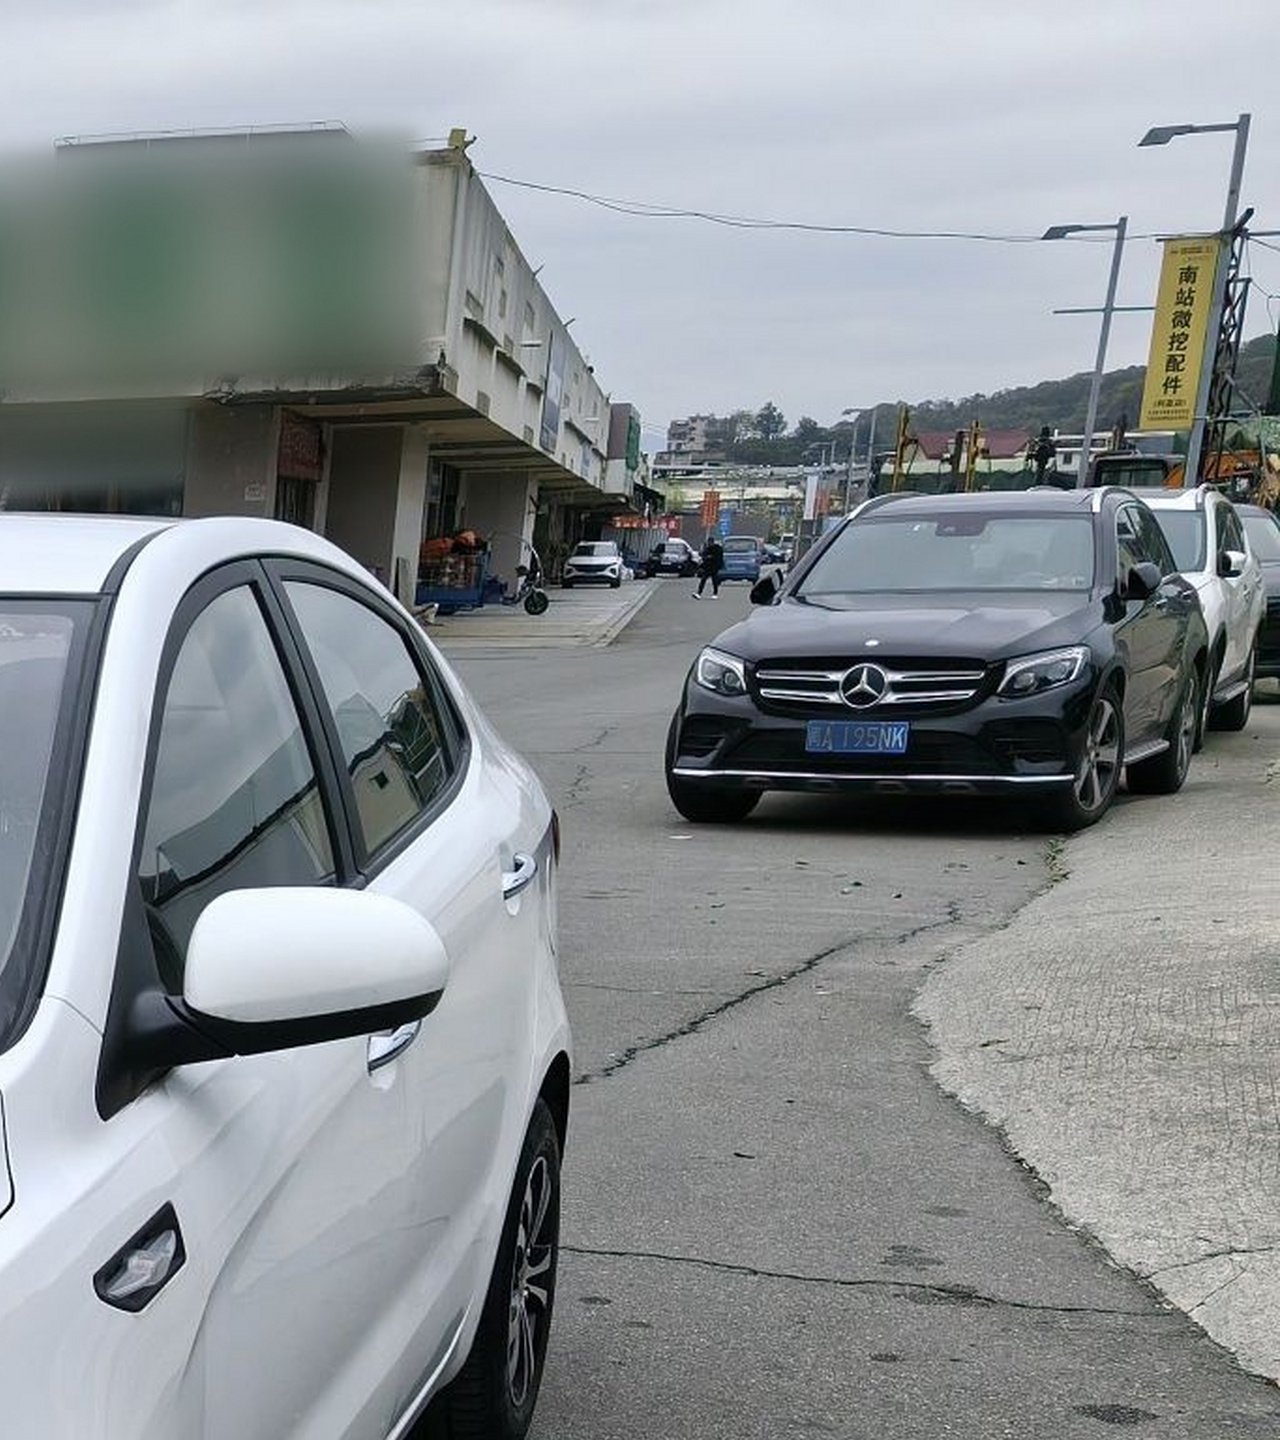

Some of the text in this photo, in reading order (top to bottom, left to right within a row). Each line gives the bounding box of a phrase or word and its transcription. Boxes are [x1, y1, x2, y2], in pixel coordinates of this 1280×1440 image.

[1162, 265, 1199, 394] 南站微挖配件
